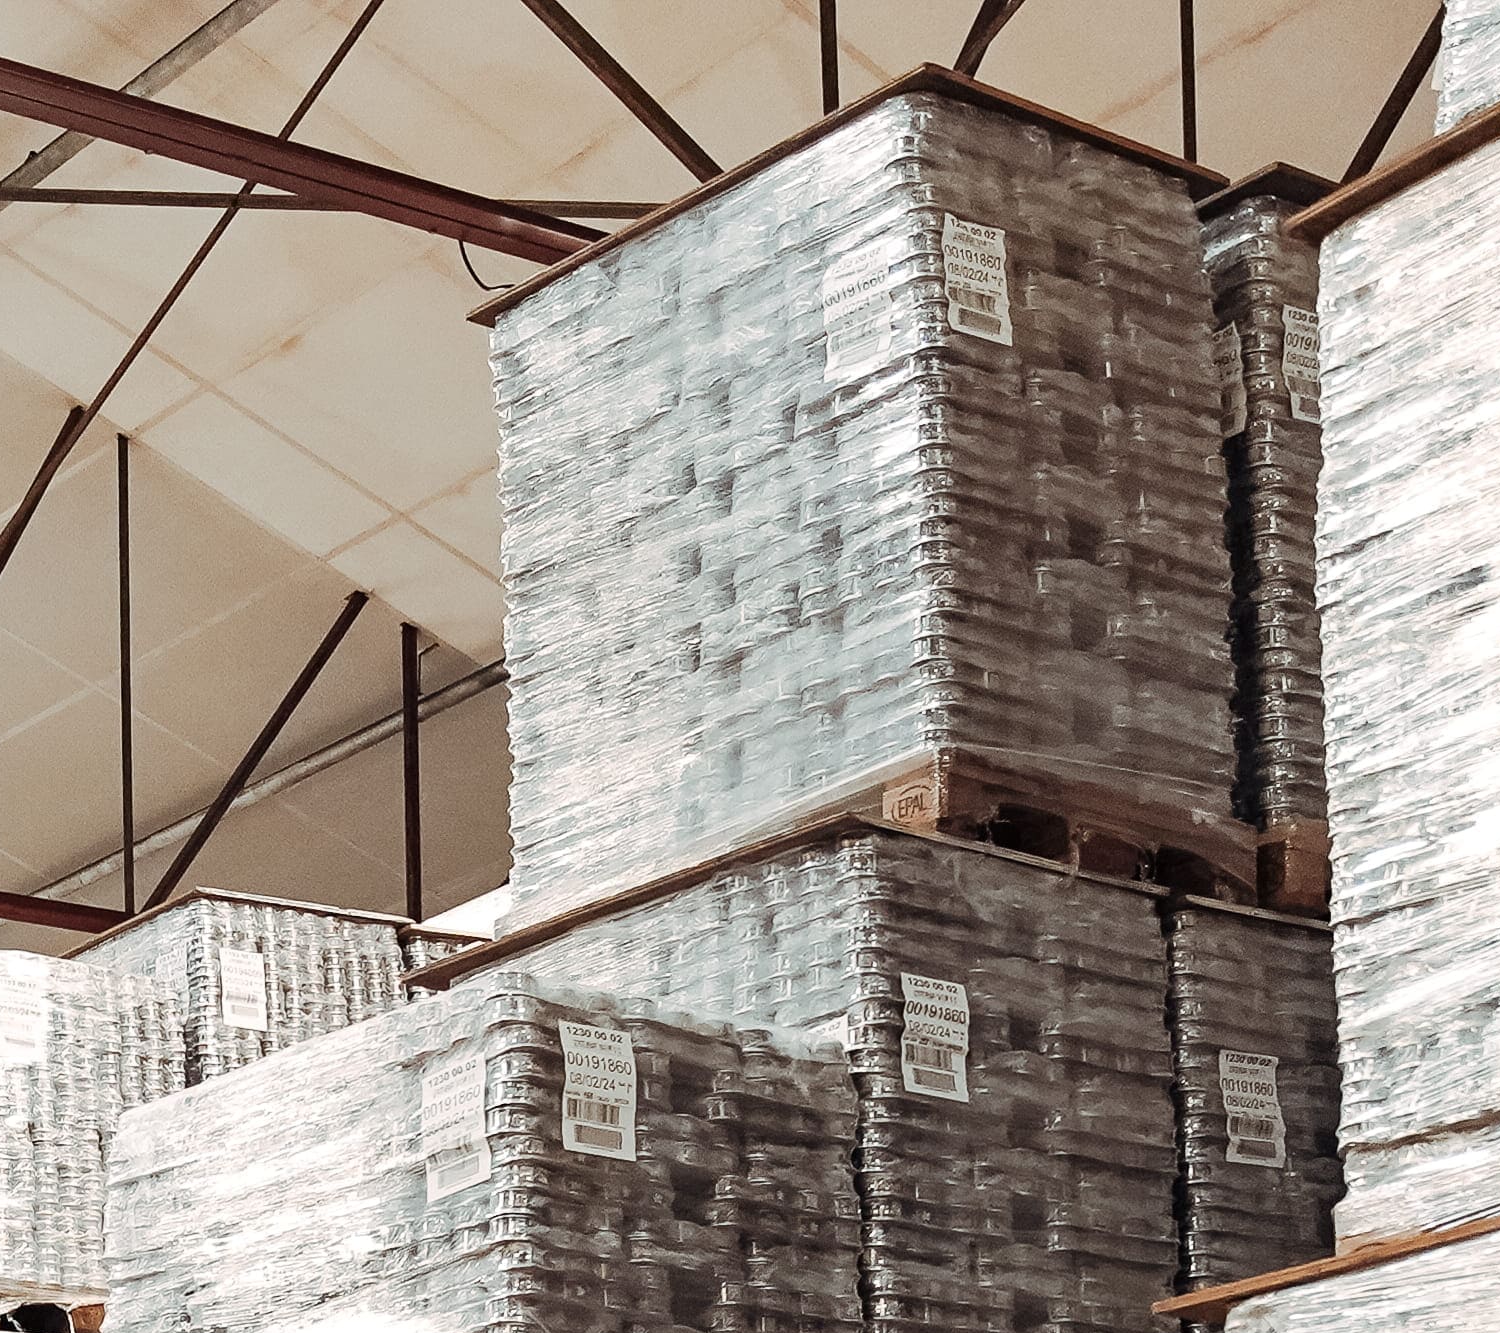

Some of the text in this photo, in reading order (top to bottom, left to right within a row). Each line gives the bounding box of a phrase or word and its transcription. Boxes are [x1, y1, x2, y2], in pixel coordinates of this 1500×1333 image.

[898, 792, 927, 818] EPAL
[932, 982, 944, 991] 00
[946, 986, 957, 994] 02
[906, 1000, 967, 1024] 00191860
[566, 1026, 623, 1044] 1230 00 02
[567, 1051, 632, 1076] 00191860
[1225, 1053, 1244, 1064] 1230
[428, 1060, 477, 1088] 1230 00 02
[569, 1071, 616, 1091] 08/02/24
[1221, 1078, 1274, 1097] 00191860
[423, 1084, 480, 1120] 00191860
